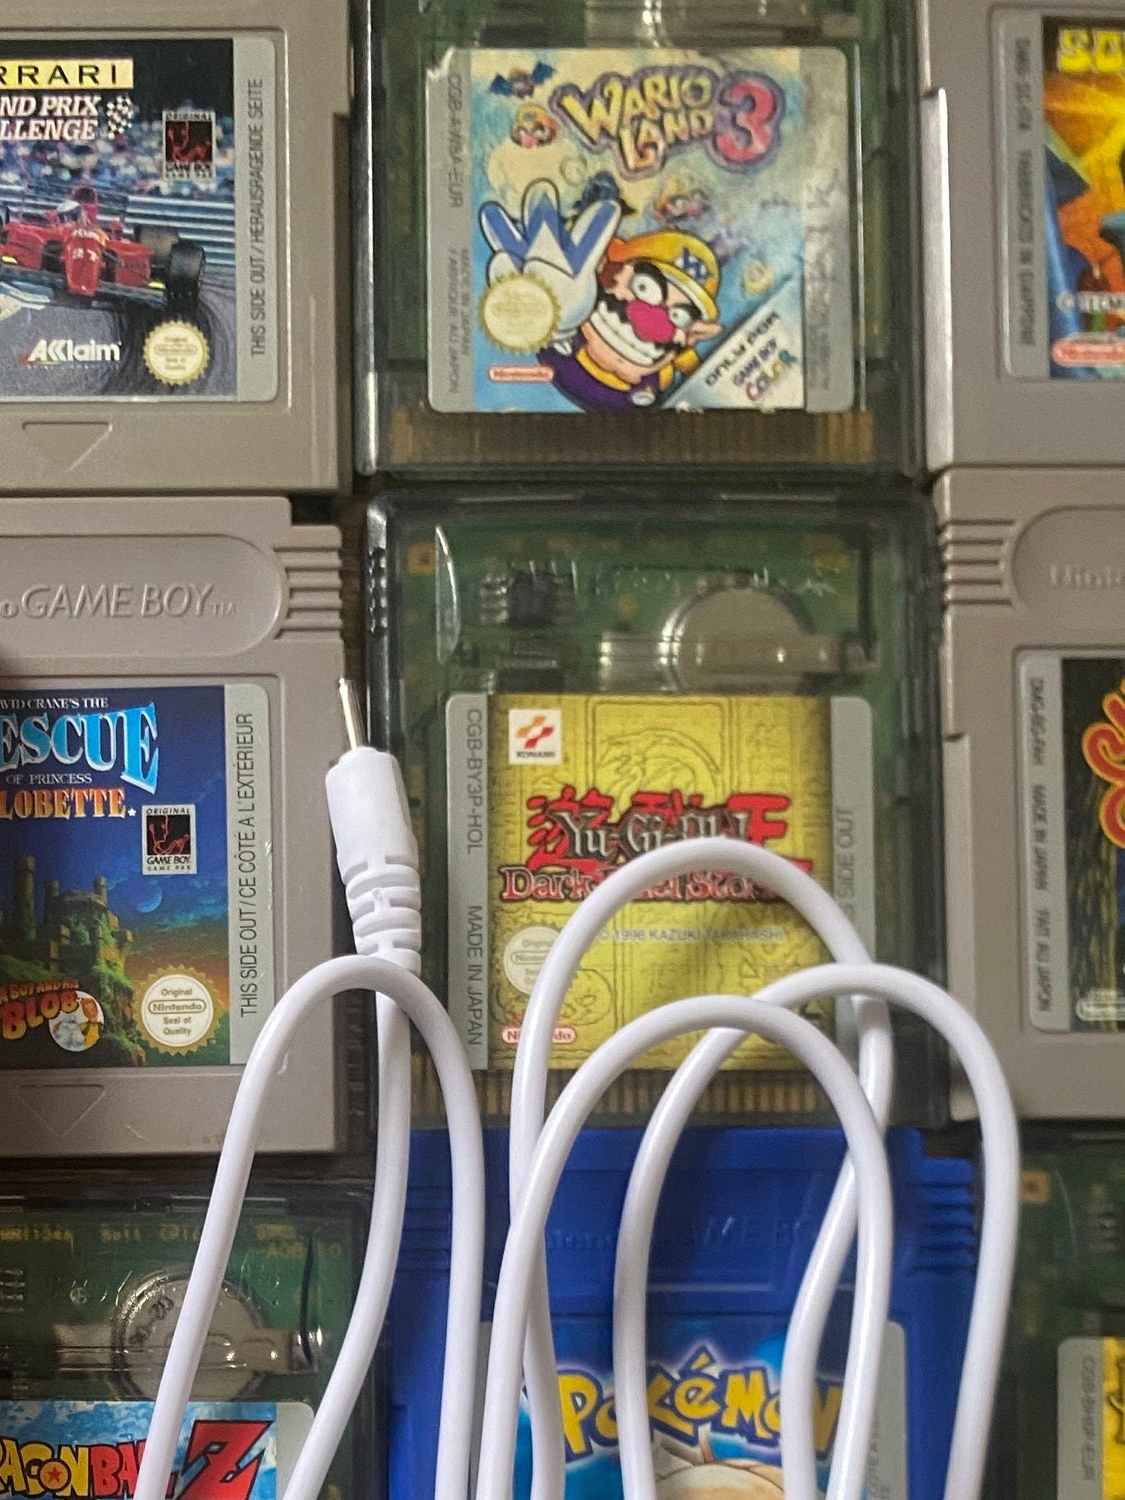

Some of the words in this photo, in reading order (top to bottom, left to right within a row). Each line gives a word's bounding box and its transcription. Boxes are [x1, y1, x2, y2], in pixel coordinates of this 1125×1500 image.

[40, 95, 102, 117] PRIX
[247, 78, 263, 119] SEITE
[562, 74, 715, 143] WARIO
[713, 79, 777, 163] 3
[619, 110, 714, 172] LAND
[249, 255, 265, 284] OUT
[250, 289, 266, 323] SIDE
[251, 323, 266, 358] THIS
[21, 583, 133, 620] GAME
[141, 583, 213, 619] BOY
[27, 698, 80, 710] CRANE'S
[82, 697, 109, 709] THE
[29, 773, 93, 785] PRINCESS
[238, 877, 256, 898] CE
[239, 907, 257, 941] OUT
[467, 904, 484, 957] MADE
[239, 944, 258, 979] SIDE
[467, 962, 483, 982] IN
[152, 1003, 204, 1013] Nintendo
[161, 987, 193, 997] Original
[240, 983, 258, 1018] THIS
[467, 985, 483, 1046] JAPAN
